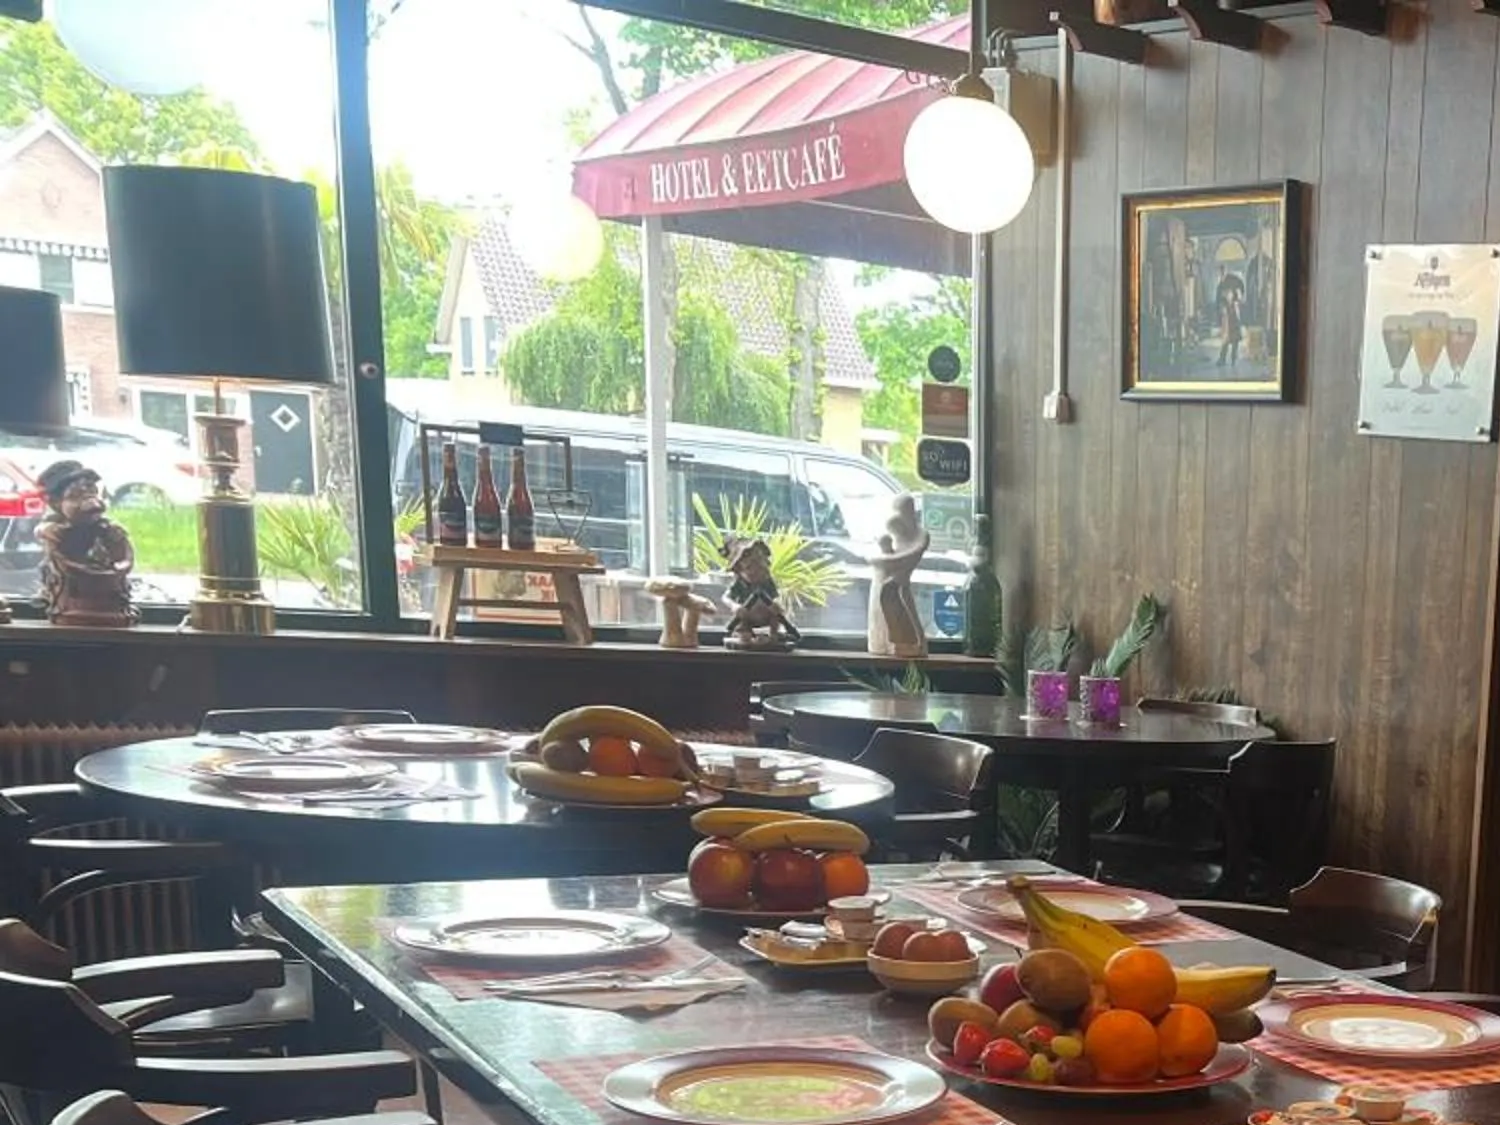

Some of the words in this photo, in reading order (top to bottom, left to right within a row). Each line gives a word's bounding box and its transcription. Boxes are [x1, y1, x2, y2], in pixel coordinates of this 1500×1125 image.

[651, 157, 719, 203] HOTEL
[721, 152, 739, 197] &
[742, 121, 846, 194] EETCAFÉ
